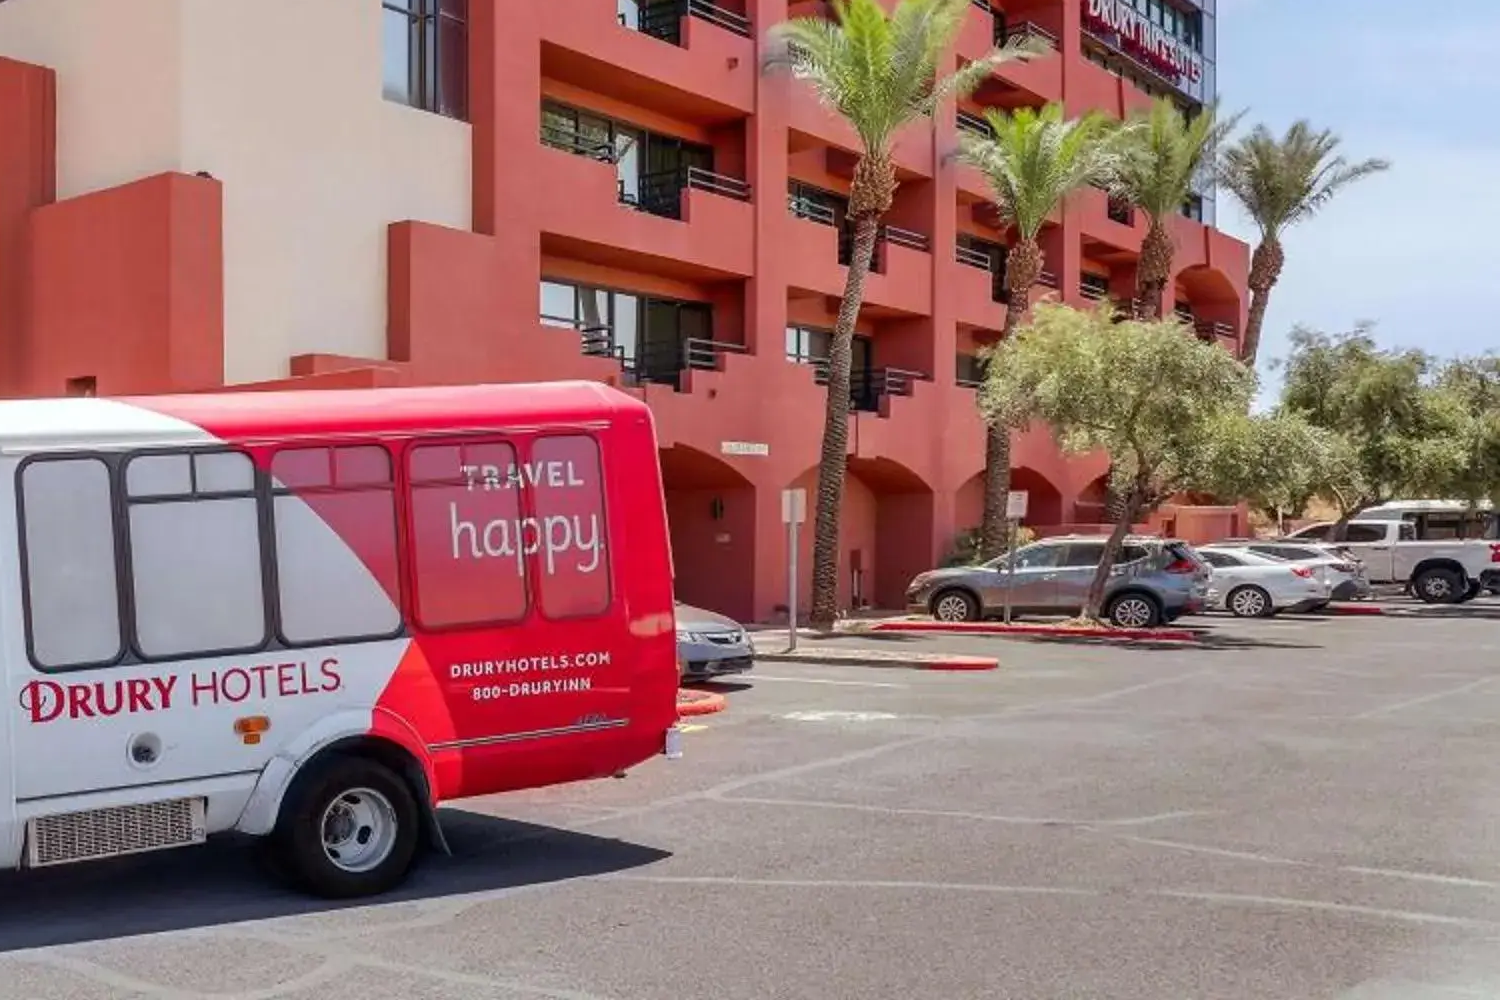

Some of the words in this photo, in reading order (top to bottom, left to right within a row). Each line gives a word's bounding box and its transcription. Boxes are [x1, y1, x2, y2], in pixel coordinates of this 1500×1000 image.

[459, 460, 585, 491] TRAVEL
[450, 651, 611, 679] DRURYHOTELS.COM
[19, 675, 178, 724] DRURY
[190, 657, 342, 706] HOTELS
[472, 677, 592, 701] 800-DRURYINN
